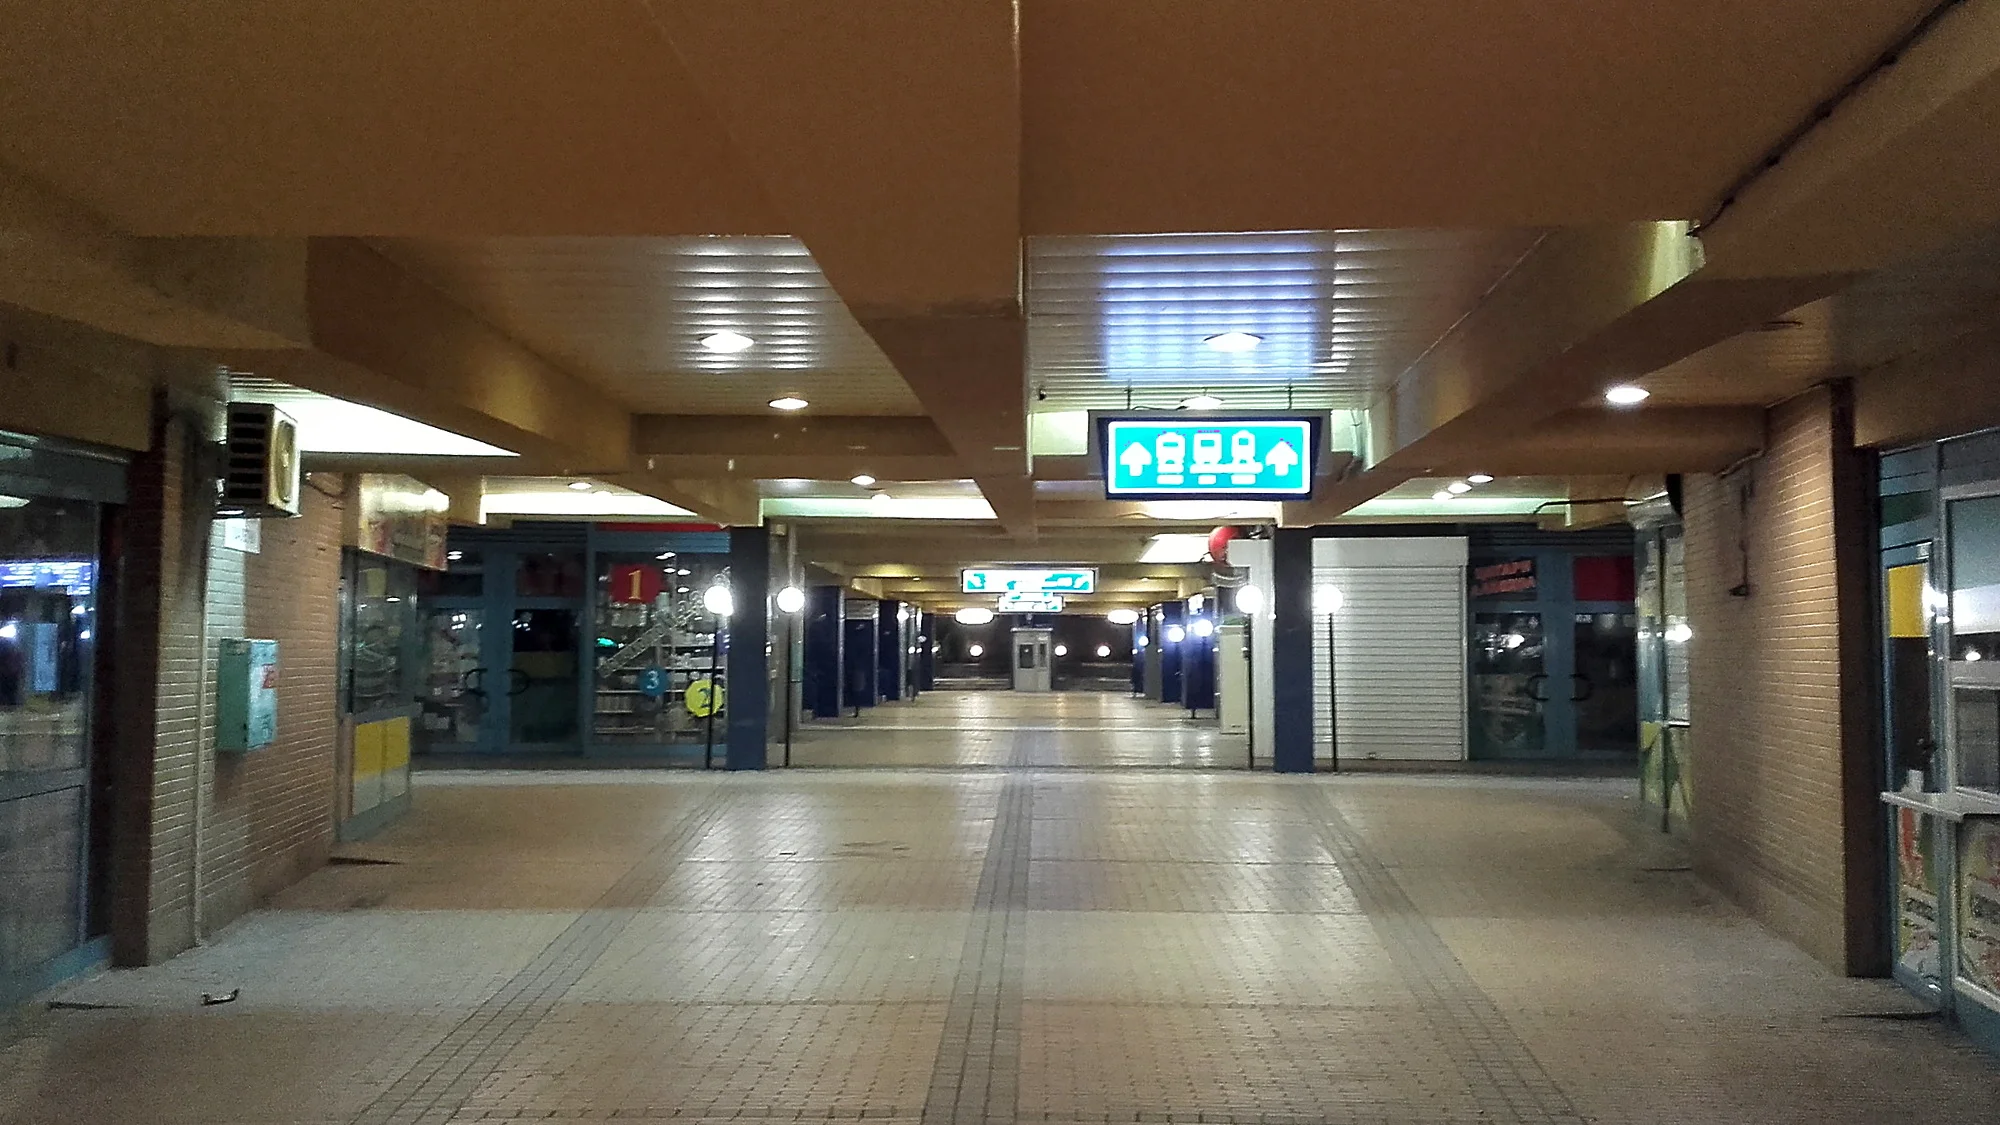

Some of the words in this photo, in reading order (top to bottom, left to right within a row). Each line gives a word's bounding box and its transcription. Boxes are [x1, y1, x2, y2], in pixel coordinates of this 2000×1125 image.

[628, 570, 642, 600] 1
[646, 670, 659, 689] 3
[697, 687, 712, 708] 2
